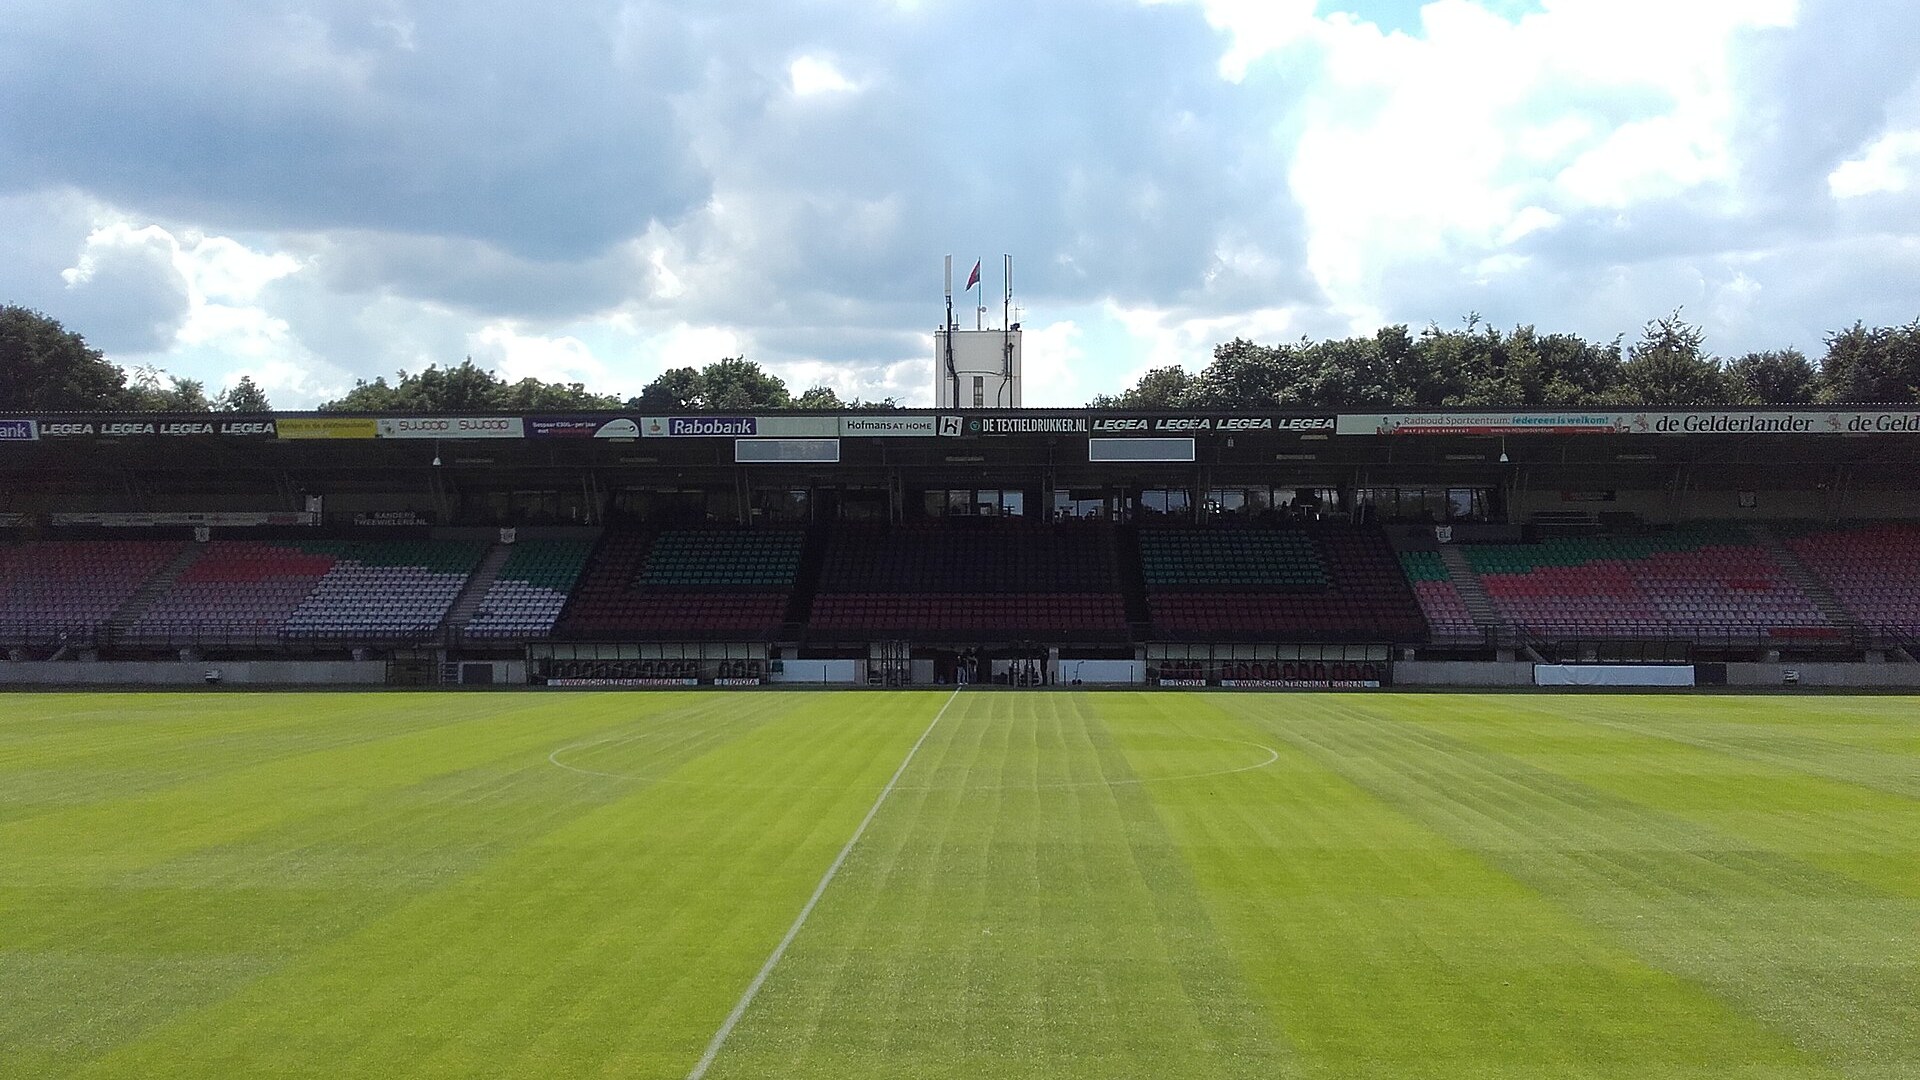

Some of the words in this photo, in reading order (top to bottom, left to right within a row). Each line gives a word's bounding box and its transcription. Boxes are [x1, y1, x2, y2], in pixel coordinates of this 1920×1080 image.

[674, 419, 751, 434] Rabobank
[847, 420, 892, 430] Hofmans
[893, 422, 905, 430] AT
[906, 422, 932, 430] HOME
[983, 419, 995, 432] DE
[996, 418, 1087, 432] TEXTIELDRUKKER.NL
[1092, 419, 1148, 430] LEGEA
[1155, 419, 1210, 430] LEGEA
[1216, 418, 1272, 430] LEGEA
[1278, 418, 1334, 430] LEGEA
[1404, 416, 1443, 425] Radboud
[1446, 416, 1510, 426] Sportcentrum:
[1567, 415, 1608, 424] welkom!
[1655, 416, 1679, 431] de
[1683, 415, 1814, 432] Gelderlander
[1847, 415, 1871, 431] de
[40, 423, 94, 435] LEGEA
[100, 423, 155, 435] LEGEA
[160, 423, 214, 435] LEGEA
[221, 422, 275, 434] LEGEA
